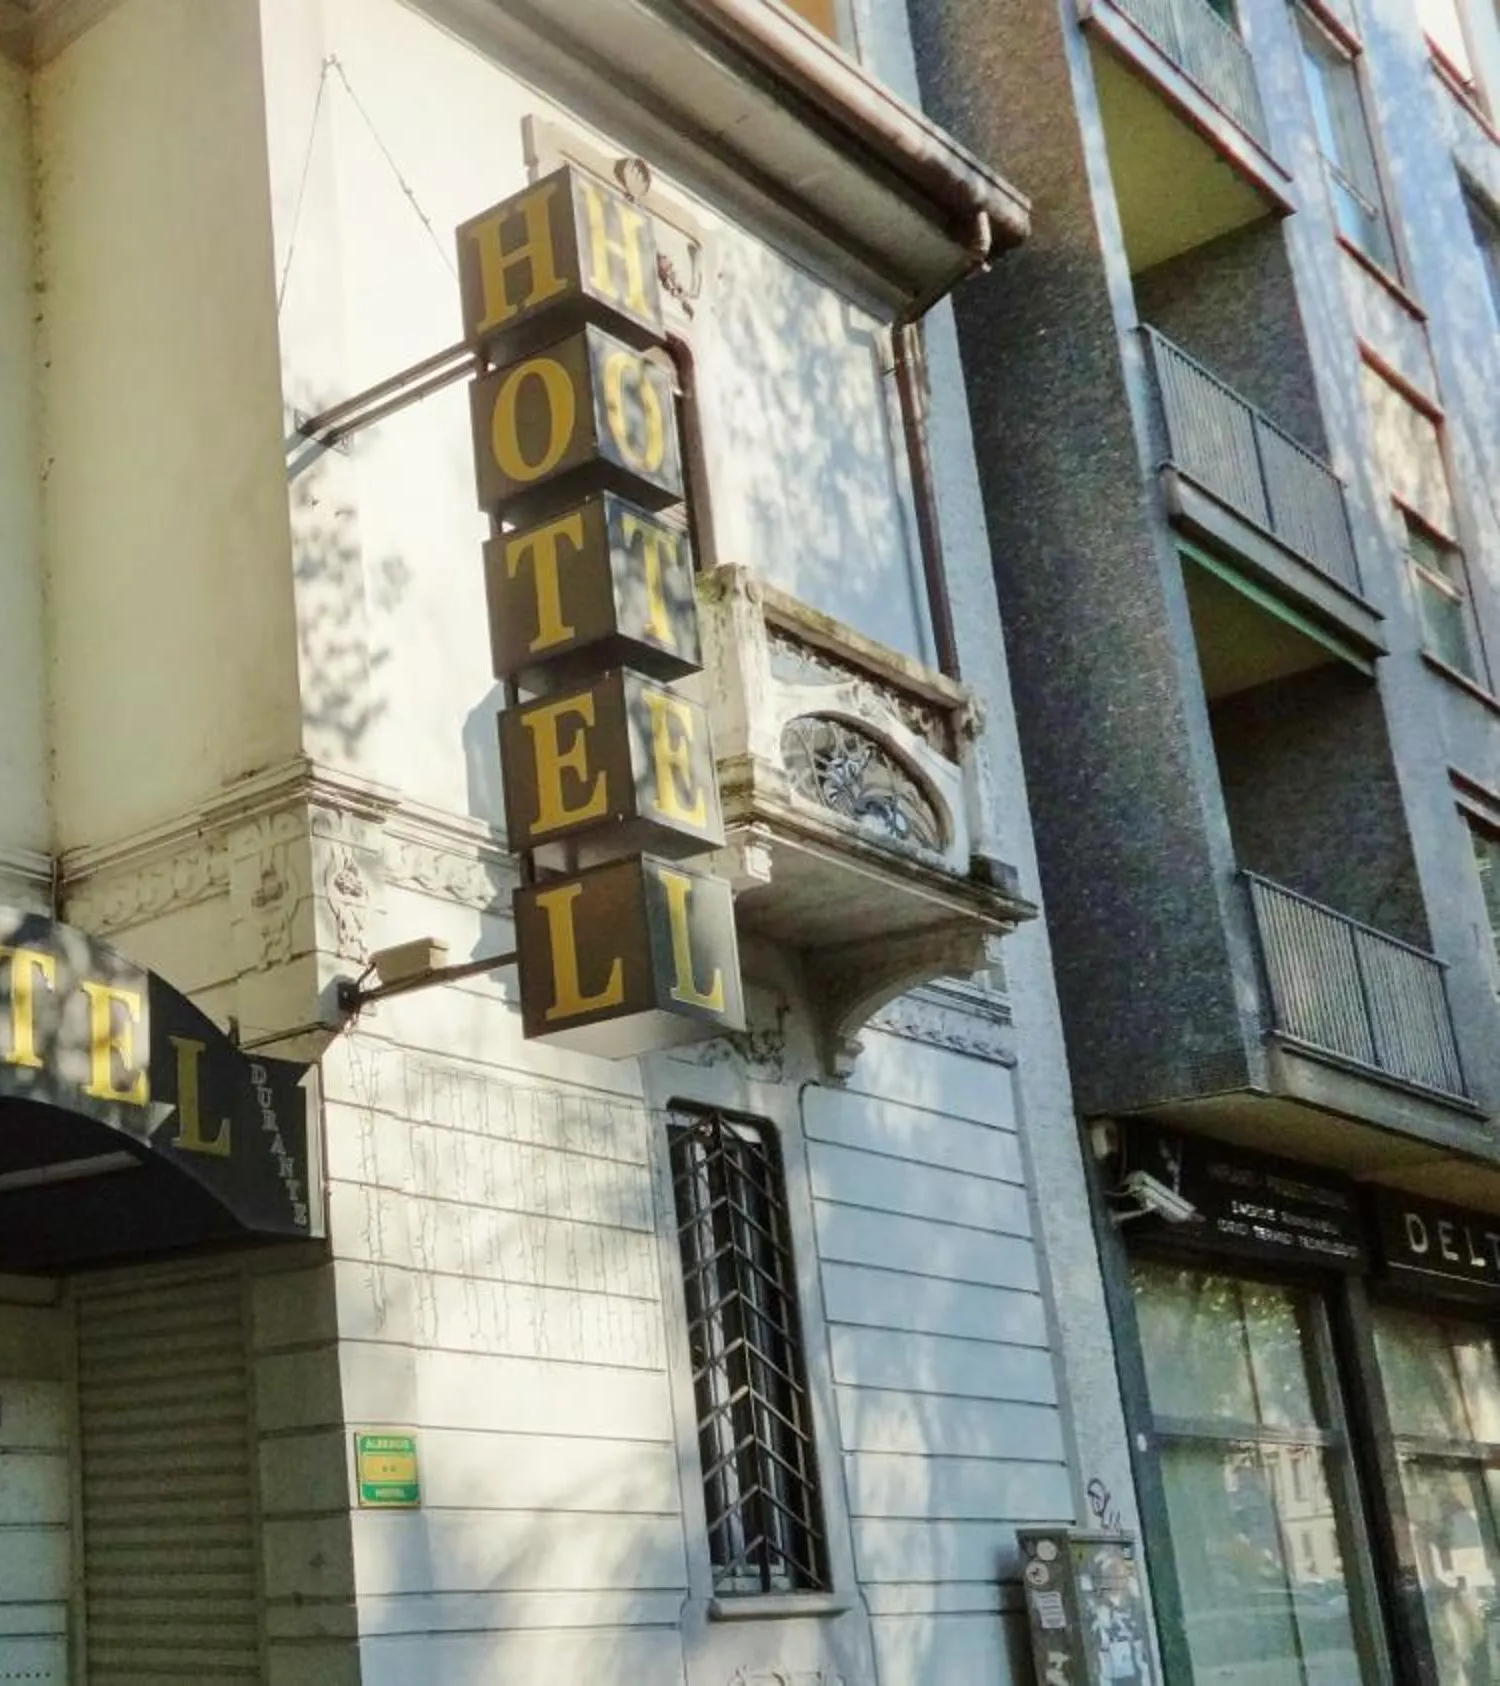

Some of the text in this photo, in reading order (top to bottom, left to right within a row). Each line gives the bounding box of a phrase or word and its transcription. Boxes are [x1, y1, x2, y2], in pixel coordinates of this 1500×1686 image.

[472, 178, 624, 1021] HOTEL
[581, 179, 726, 1013] HOTEL
[250, 1063, 308, 1226] DURANTE
